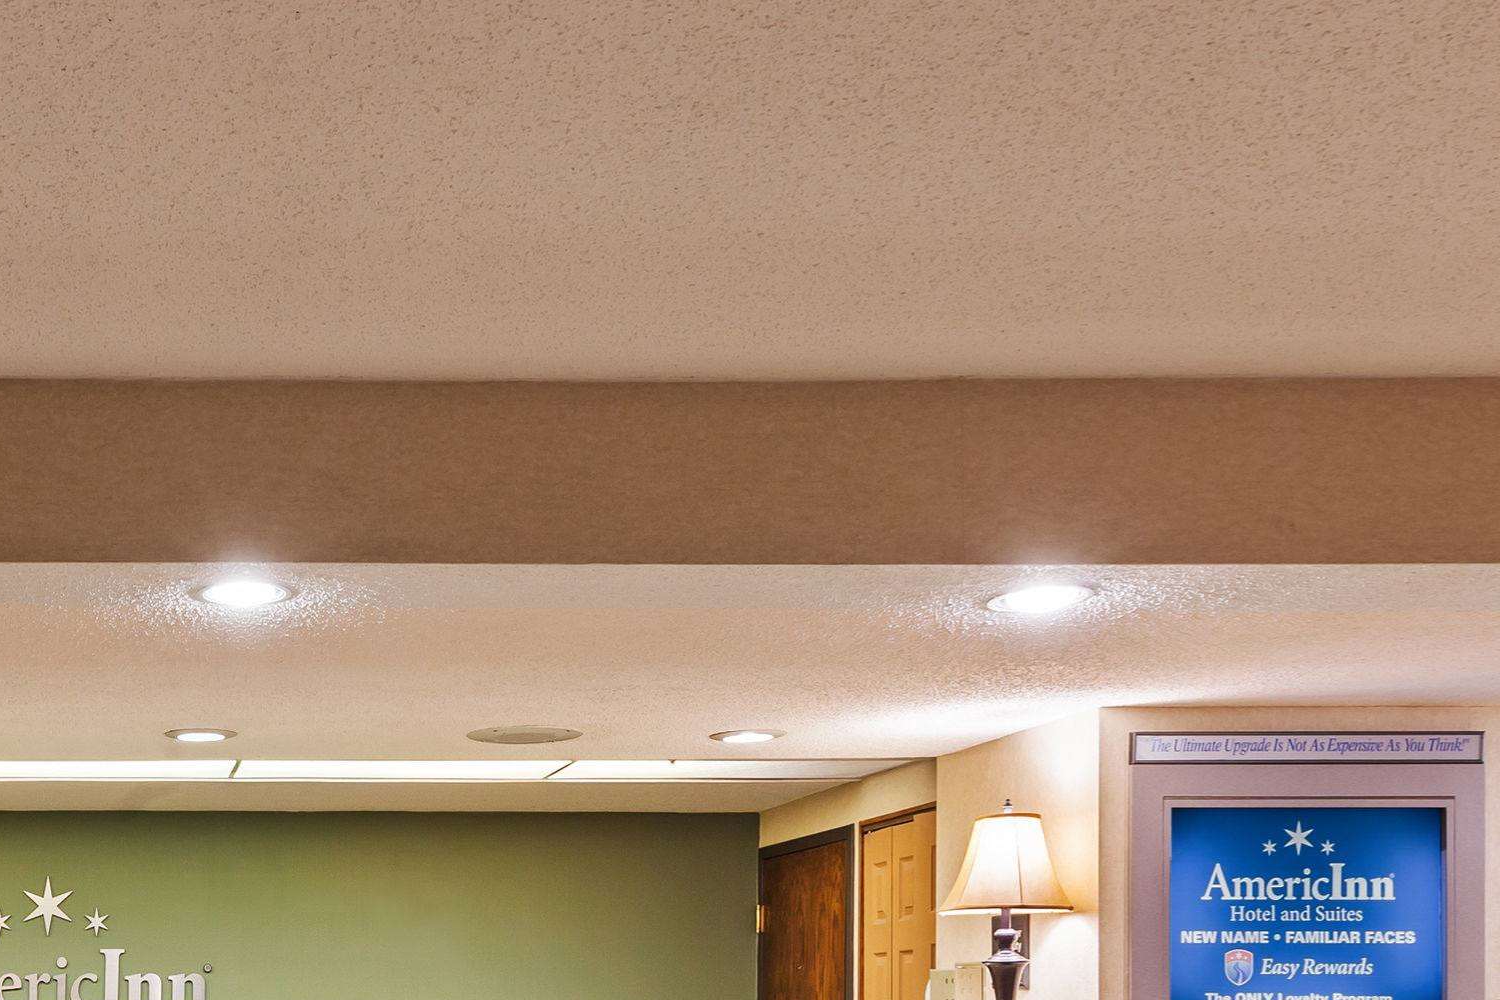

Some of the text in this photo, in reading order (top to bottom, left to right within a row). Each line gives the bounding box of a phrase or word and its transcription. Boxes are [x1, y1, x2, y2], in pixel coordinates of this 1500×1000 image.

[1173, 738, 1221, 752] Ultimate
[1224, 738, 1270, 755] Upgrade
[1273, 738, 1284, 752] Is
[1286, 738, 1307, 752] Not
[1310, 738, 1325, 752] As
[1327, 737, 1383, 755] Expensive
[1385, 738, 1401, 752] As
[1404, 738, 1425, 752] You
[1230, 905, 1364, 922] Hotel and Suites
[1180, 930, 1417, 944] NEW NAME FAMILIAR FACES
[1260, 957, 1375, 979] Easy Rewards
